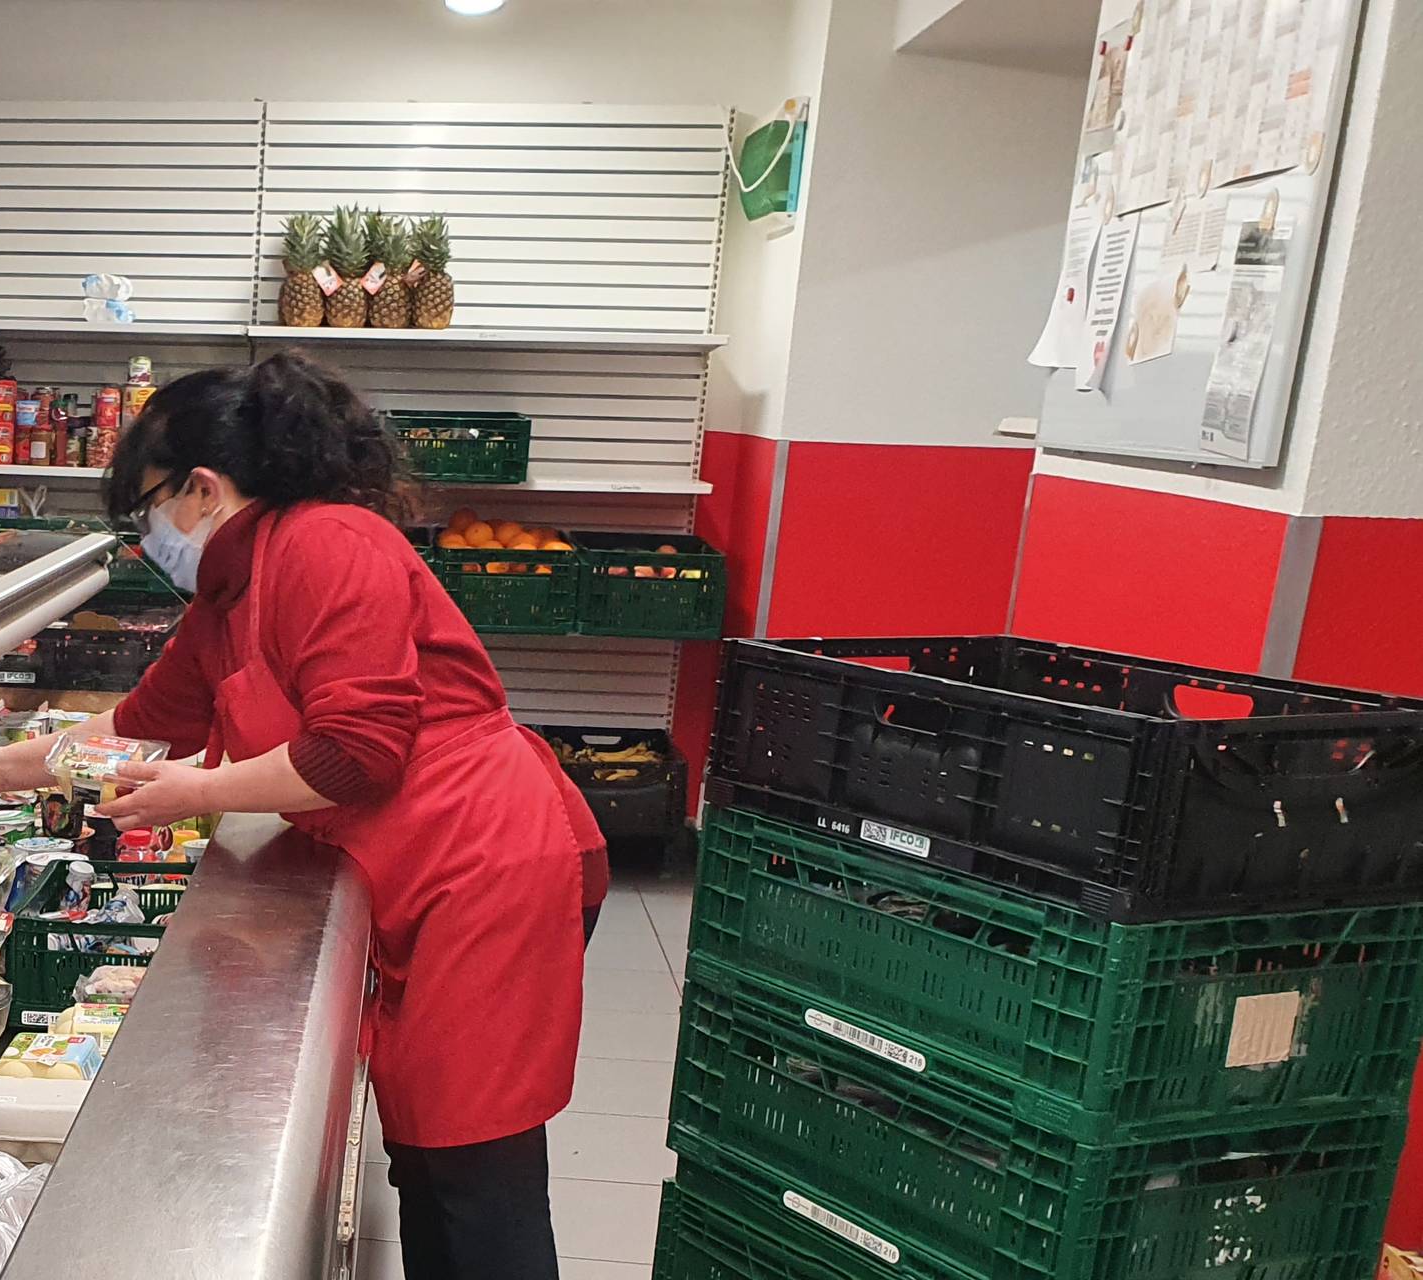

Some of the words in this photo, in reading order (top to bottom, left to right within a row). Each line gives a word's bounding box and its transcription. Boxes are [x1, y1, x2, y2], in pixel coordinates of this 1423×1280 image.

[817, 816, 827, 829] LL
[831, 821, 850, 835] 6416
[889, 829, 914, 845] IFCO
